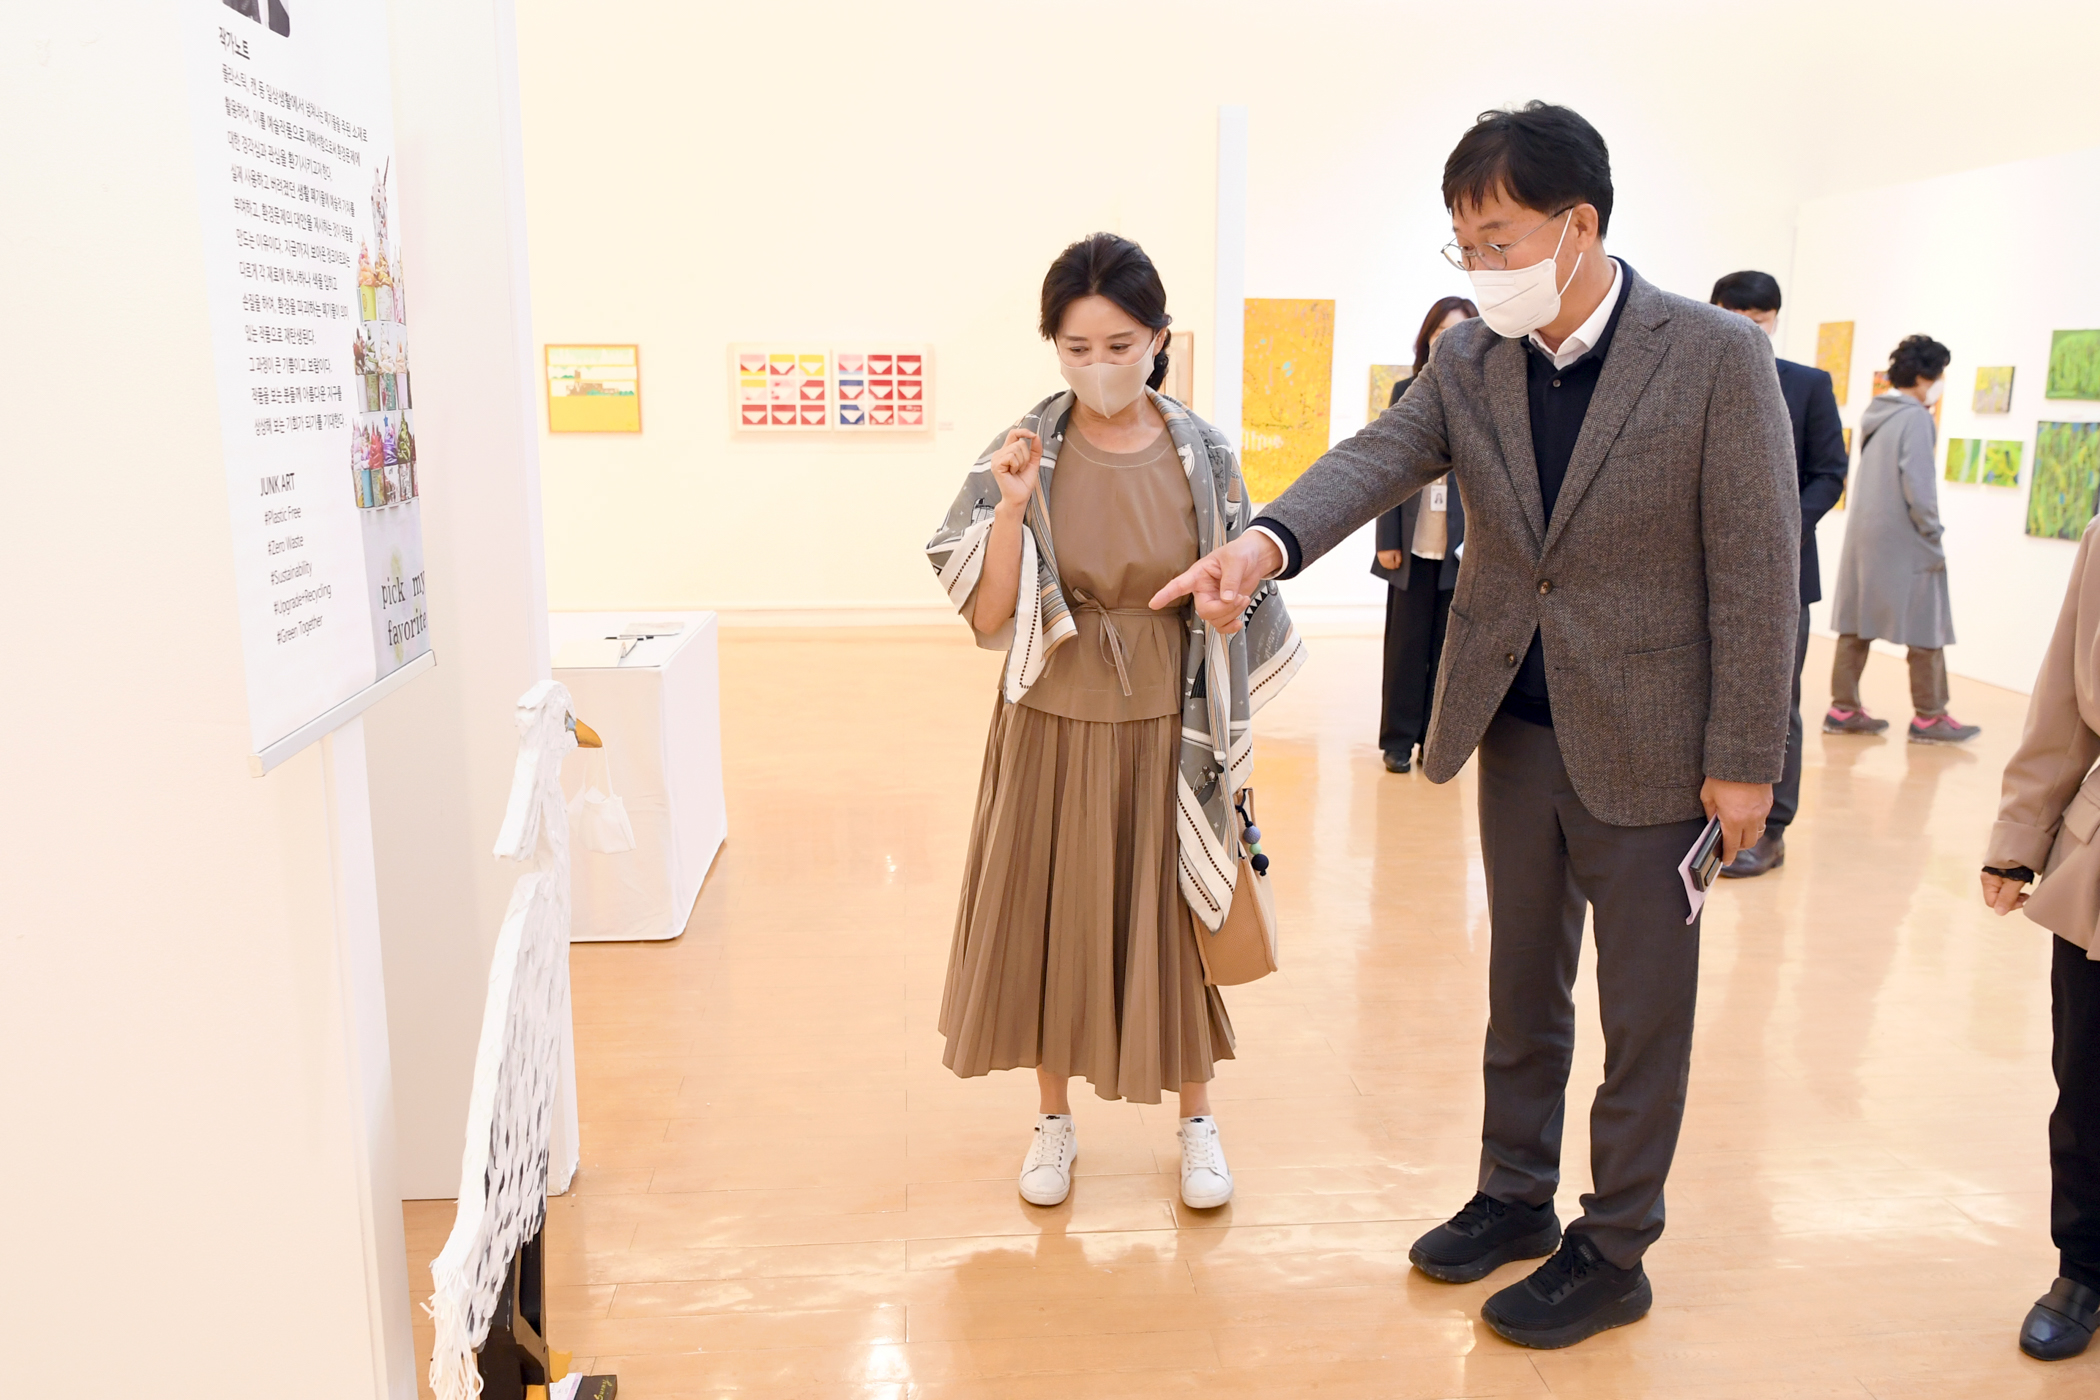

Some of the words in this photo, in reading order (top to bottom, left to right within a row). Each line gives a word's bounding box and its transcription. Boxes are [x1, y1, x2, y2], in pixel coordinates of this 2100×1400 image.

[218, 26, 251, 61] 작가노트
[250, 77, 258, 97] 캔
[257, 80, 266, 100] 등
[265, 83, 305, 115] 일상생활에서
[351, 125, 368, 143] 소재로
[252, 109, 267, 131] 이를
[266, 115, 306, 143] 예술작품으로
[227, 130, 241, 152] 대한
[241, 135, 267, 159] 경각심과
[267, 144, 287, 168] 관심을
[230, 165, 244, 184] 실제
[244, 169, 271, 190] 사용하고
[270, 178, 297, 199] 버려졌던
[296, 183, 310, 203] 생활
[261, 202, 293, 226] 환경문제의
[293, 212, 313, 232] 대안을
[340, 224, 354, 244] 작품을
[235, 228, 256, 250] 만드는
[256, 233, 284, 254] 이유이다.
[284, 239, 310, 260] 지금까지
[310, 244, 327, 263] 보아온
[238, 261, 259, 281] 다르게
[258, 264, 266, 278] 각
[266, 265, 286, 285] 재료에
[285, 268, 312, 288] 하나하나
[311, 272, 324, 291] 색을
[242, 293, 262, 313] 손질을
[277, 296, 297, 316] 환경을
[296, 299, 322, 318] 파괴하는
[244, 324, 259, 343] 있는
[258, 325, 284, 344] 작품으로
[248, 356, 256, 372] 그
[255, 356, 274, 375] 과정이
[274, 356, 282, 375] 큰
[282, 357, 308, 375] 기쁨이고
[307, 357, 333, 375] 보람이다.
[251, 386, 270, 405] 작품을
[270, 389, 283, 405] 보는
[283, 386, 303, 404] 분들께
[302, 385, 327, 403] 아름다운
[326, 385, 343, 402] 지구를
[254, 417, 273, 437] 상상해
[273, 419, 286, 434] 보는
[285, 415, 305, 431] 기회가
[304, 413, 323, 431] 되기를
[323, 412, 348, 429] 기대한다.
[260, 475, 280, 496] JUNK
[281, 472, 295, 492] ART
[265, 508, 287, 526] #Plastic
[288, 505, 301, 520] Free
[268, 540, 285, 556] #Zero
[286, 535, 304, 551] Waste
[271, 560, 312, 586] #Sustainability
[381, 576, 406, 610] pick
[411, 570, 425, 597] my
[277, 628, 298, 645] #Green
[299, 614, 323, 637] Together
[388, 607, 426, 646] favorite
